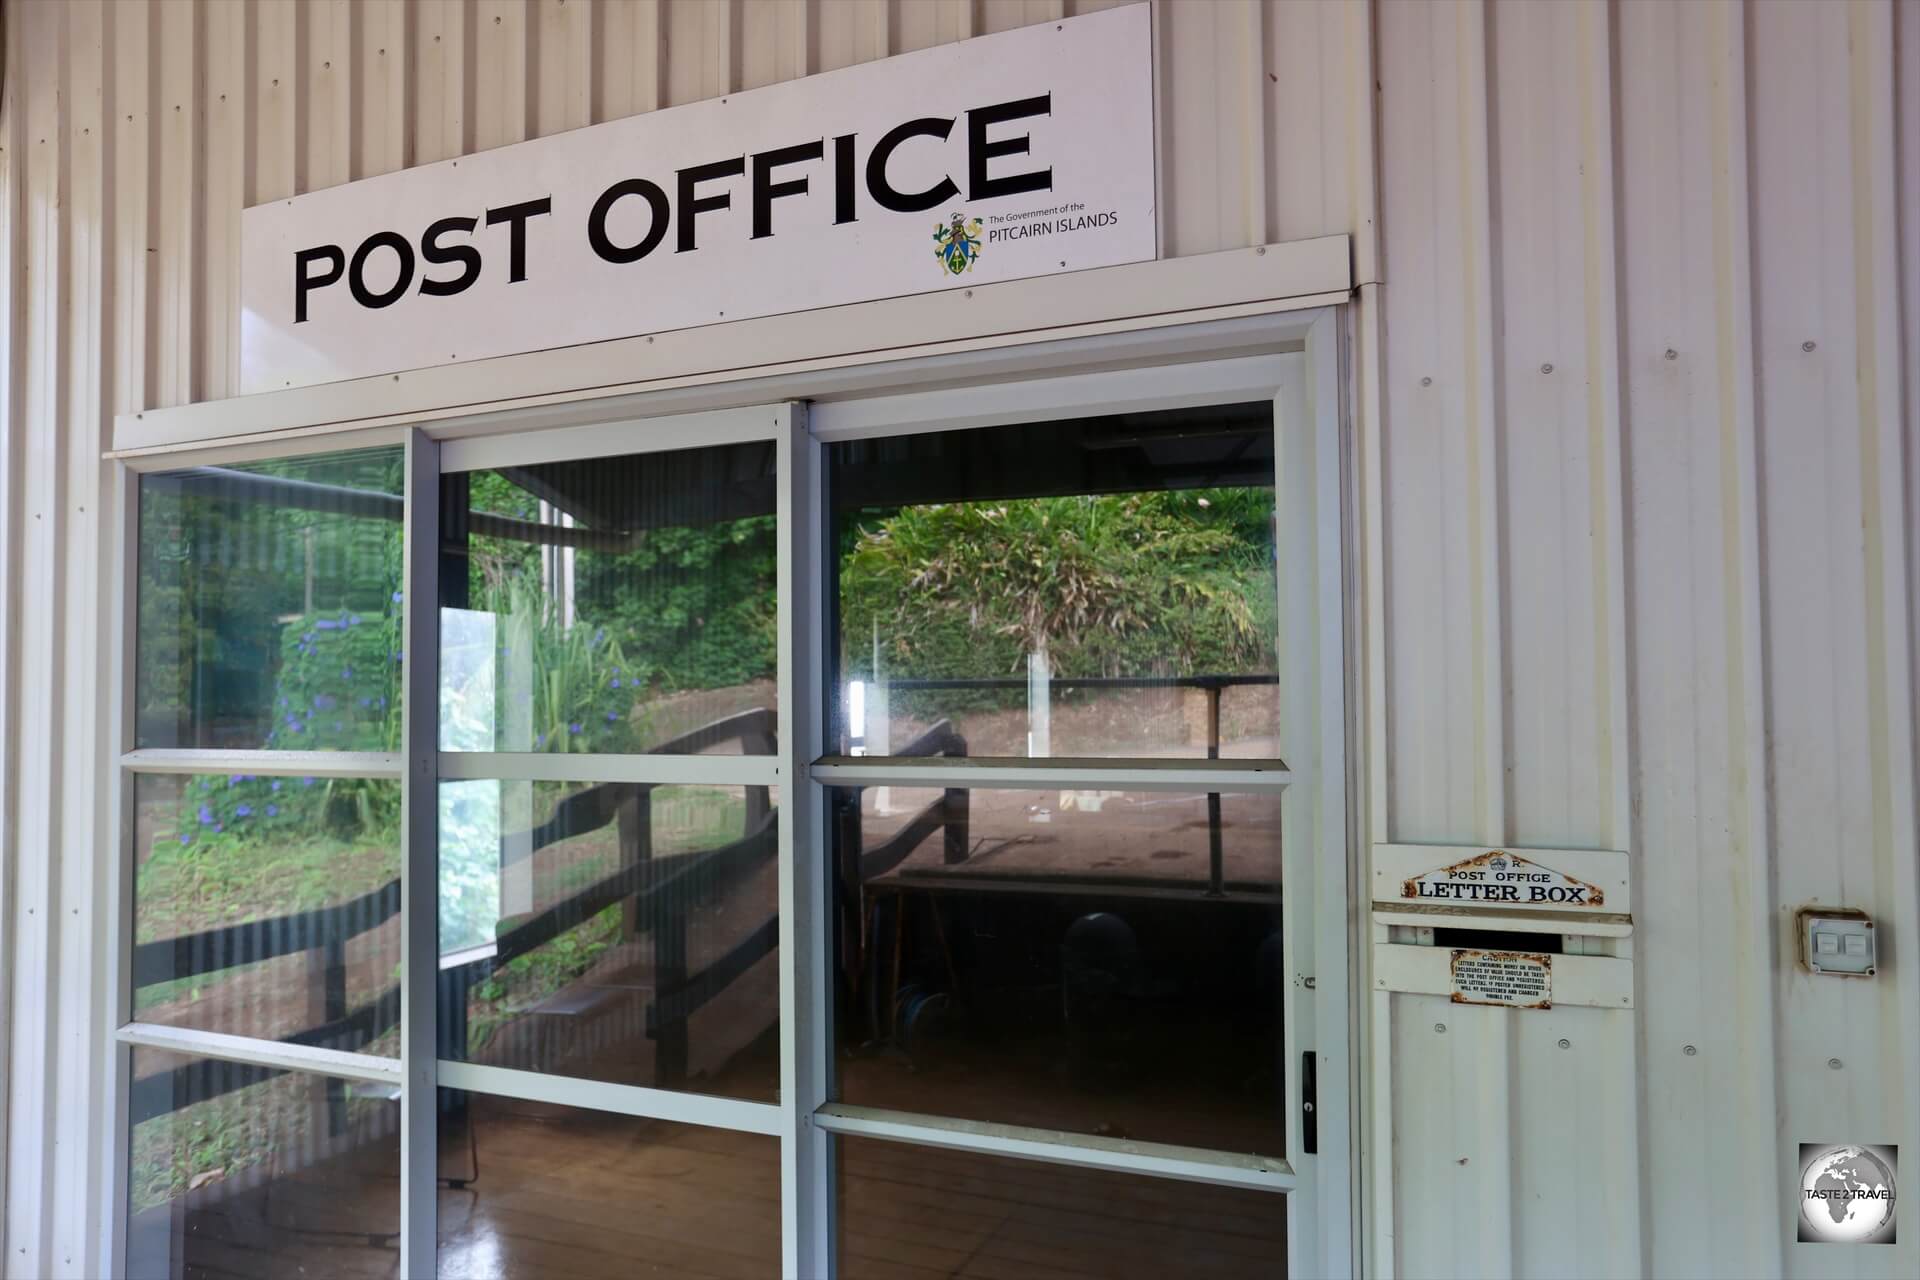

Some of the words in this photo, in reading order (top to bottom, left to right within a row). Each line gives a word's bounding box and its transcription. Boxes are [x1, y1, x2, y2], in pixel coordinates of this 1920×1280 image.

[294, 193, 552, 324] POST
[587, 90, 1052, 265] OFFICE
[989, 215, 1005, 225] The
[1005, 206, 1058, 223] Government
[1059, 203, 1069, 214] of
[1070, 202, 1085, 212] the
[989, 222, 1052, 244] PITCAIRN
[1056, 211, 1118, 233] ISLANDS
[1449, 871, 1486, 881] POST
[1495, 872, 1551, 883] OFFICE
[1417, 881, 1521, 901] LETTER
[1528, 886, 1586, 903] BOX
